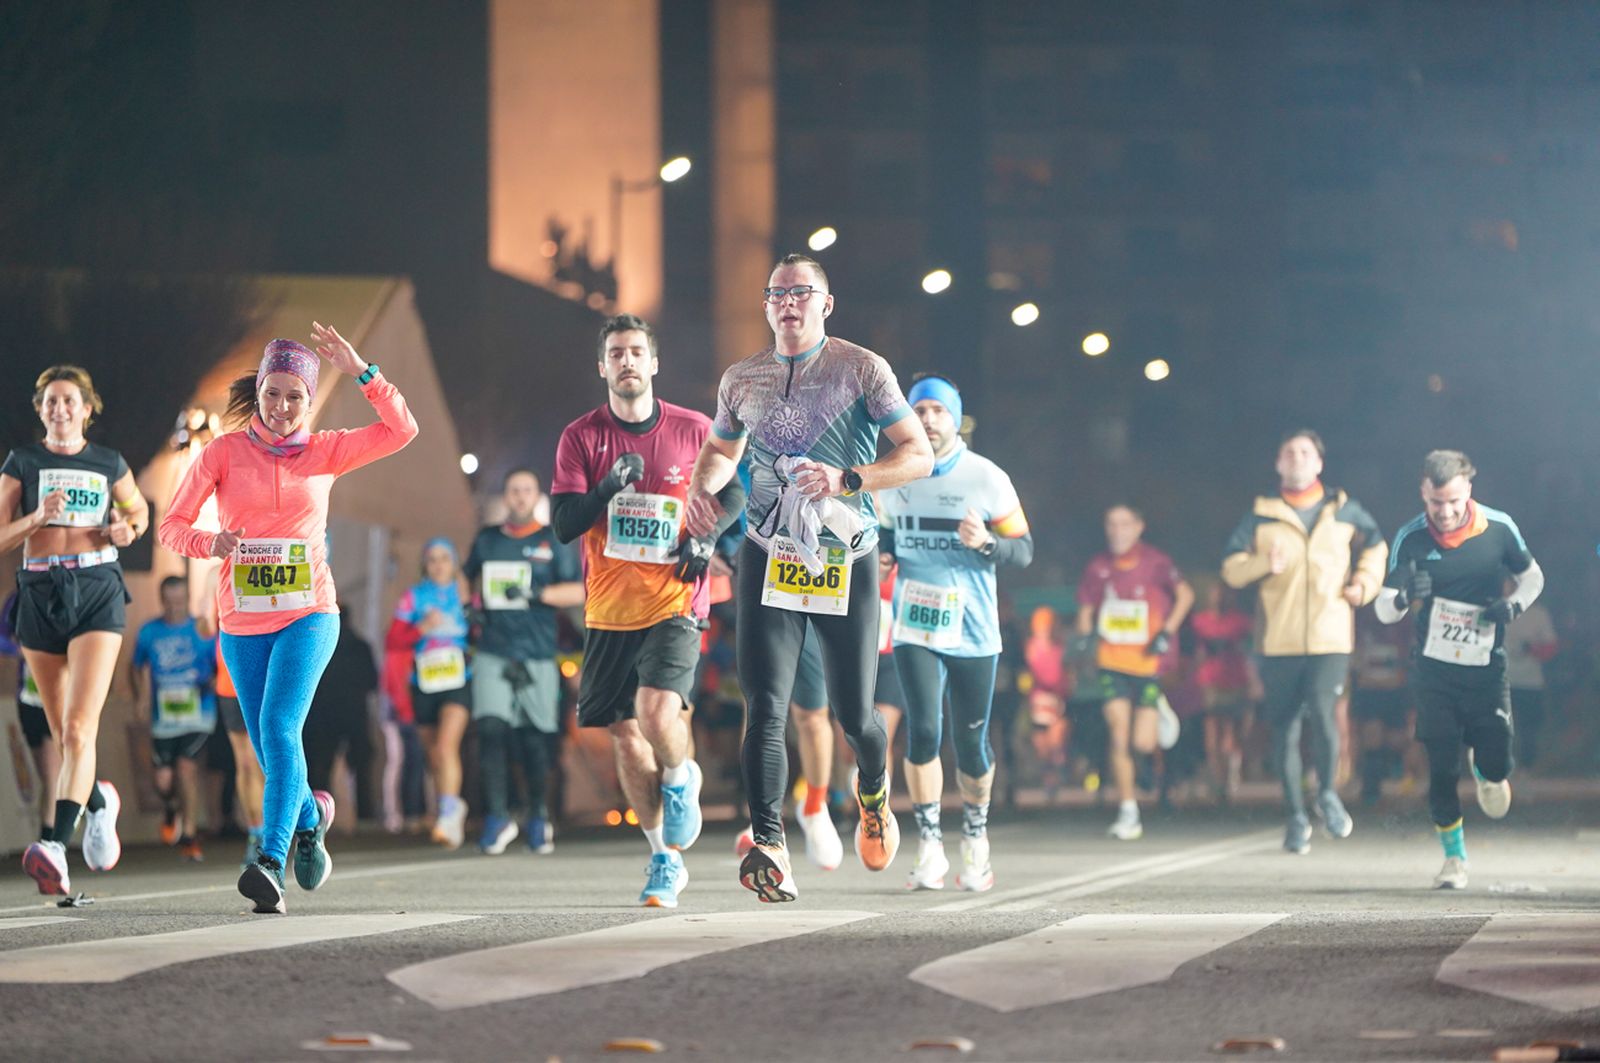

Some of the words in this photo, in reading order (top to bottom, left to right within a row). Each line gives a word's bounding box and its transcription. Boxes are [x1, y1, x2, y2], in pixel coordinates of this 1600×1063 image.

[617, 517, 671, 540] 13520
[247, 546, 271, 555] NOCHE
[272, 546, 283, 555] DE
[776, 552, 792, 562] SAN
[240, 556, 255, 565] SAN
[247, 565, 297, 588] 4647
[908, 603, 951, 628] 8686
